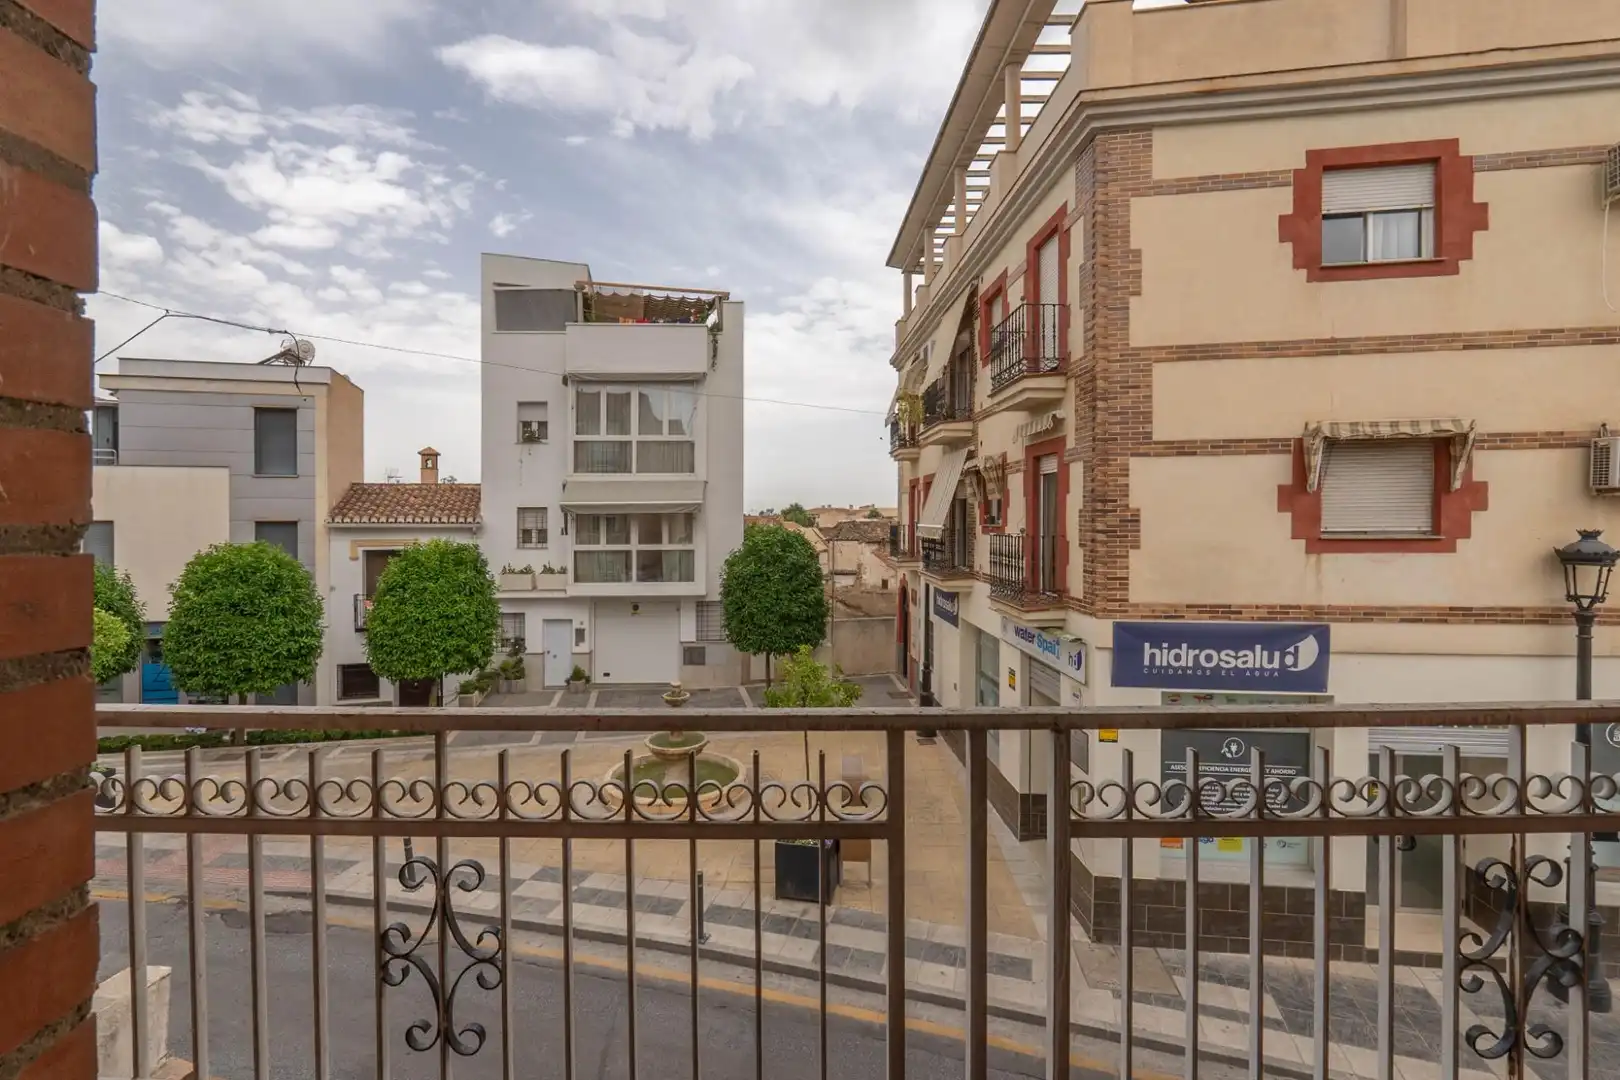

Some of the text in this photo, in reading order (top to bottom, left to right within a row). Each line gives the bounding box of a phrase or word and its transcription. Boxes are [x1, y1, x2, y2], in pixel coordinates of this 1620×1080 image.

[1013, 624, 1036, 645] water
[1143, 634, 1320, 672] hidrosalud
[1143, 667, 1211, 676] CUIDAMOS
[1246, 670, 1280, 678] AGUA
[1271, 768, 1296, 776] AHORRO
